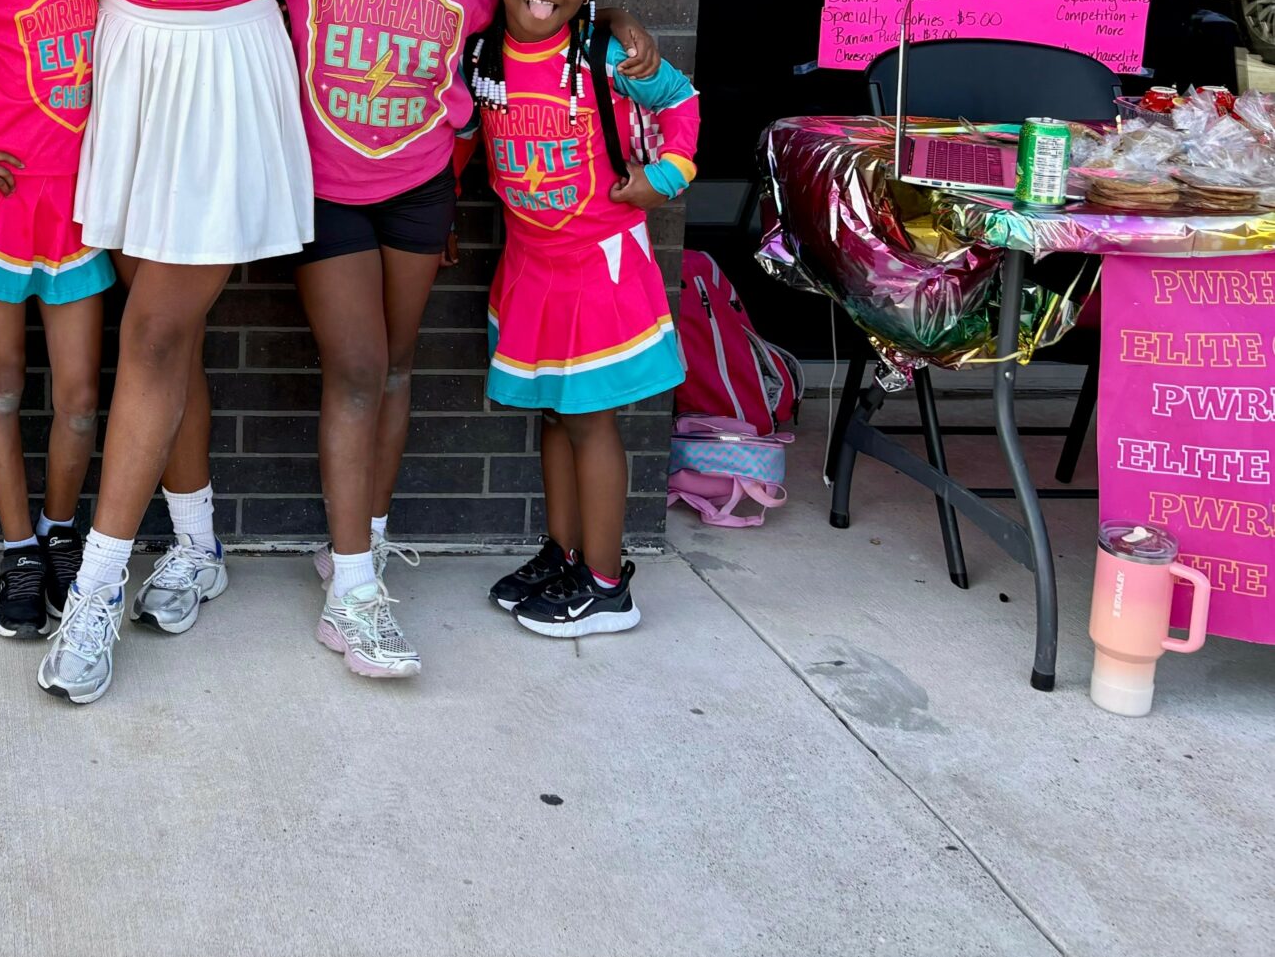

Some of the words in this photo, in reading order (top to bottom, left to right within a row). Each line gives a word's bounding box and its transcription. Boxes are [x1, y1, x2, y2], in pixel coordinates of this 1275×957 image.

[822, 6, 888, 31] Specialty
[956, 9, 1003, 27] $5.00
[1056, 5, 1126, 24] Competition
[1095, 25, 1125, 36] More
[324, 23, 442, 81] ELITE
[831, 27, 874, 45] Banana
[1116, 62, 1140, 73] Cheer
[328, 86, 428, 129] CHEER
[493, 137, 582, 174] ELITE
[504, 184, 579, 211] CHEER
[1120, 329, 1267, 368] ELITE
[1151, 382, 1275, 422] PWR
[1117, 437, 1271, 485] ELITE
[1149, 491, 1275, 538] PWR
[1114, 570, 1125, 609] STANLEY
